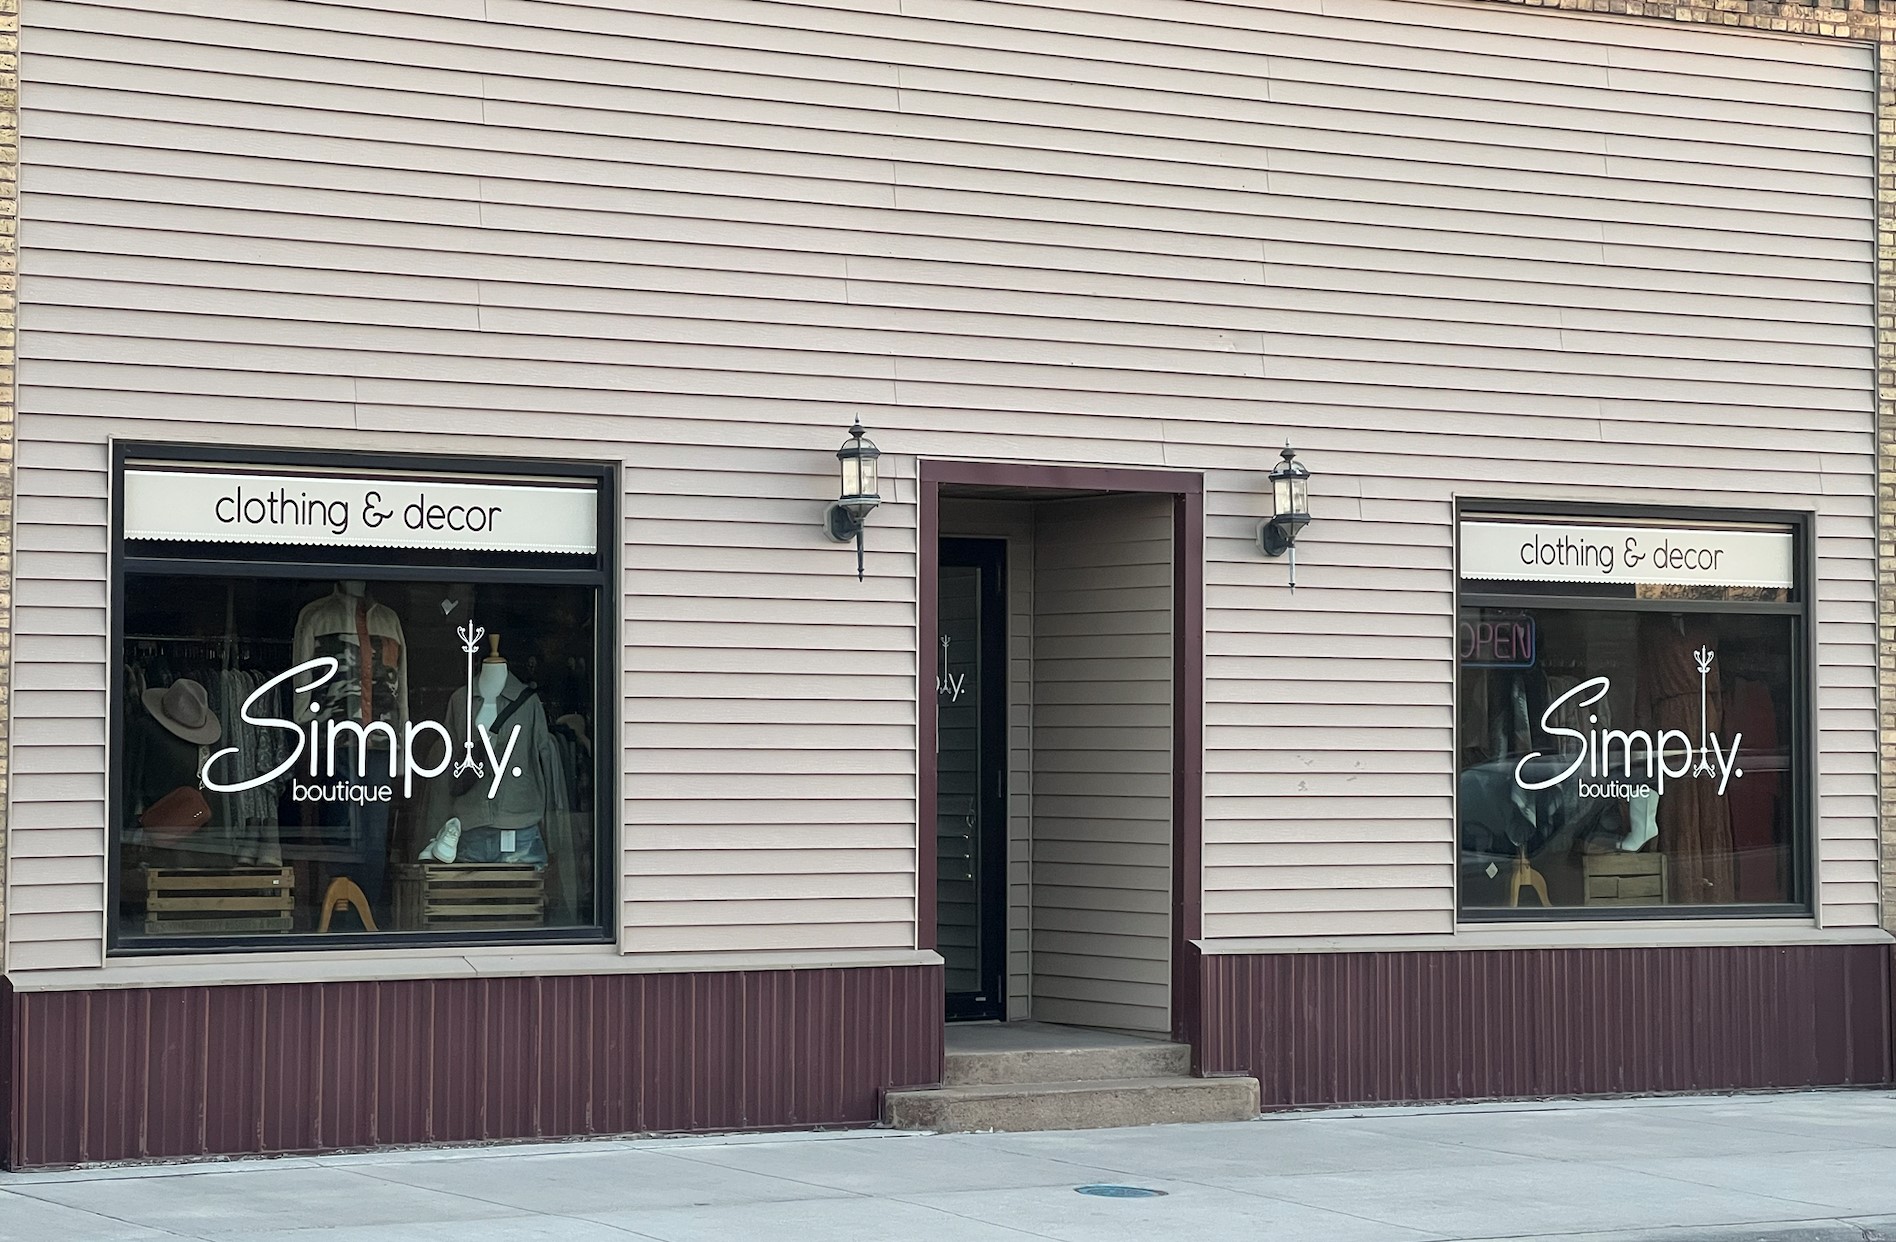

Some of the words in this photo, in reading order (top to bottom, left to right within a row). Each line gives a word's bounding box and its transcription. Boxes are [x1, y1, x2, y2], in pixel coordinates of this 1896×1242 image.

[214, 486, 349, 535] clothing
[362, 491, 394, 528] &
[403, 493, 502, 533] decor
[1520, 533, 1614, 574] clothing
[1623, 536, 1646, 568] &
[1653, 538, 1724, 571] decor
[1460, 622, 1532, 659] OPEN
[200, 619, 523, 800] Simply.
[1514, 644, 1743, 796] Simply.
[291, 779, 393, 807] boutique
[1578, 778, 1651, 802] boutique
